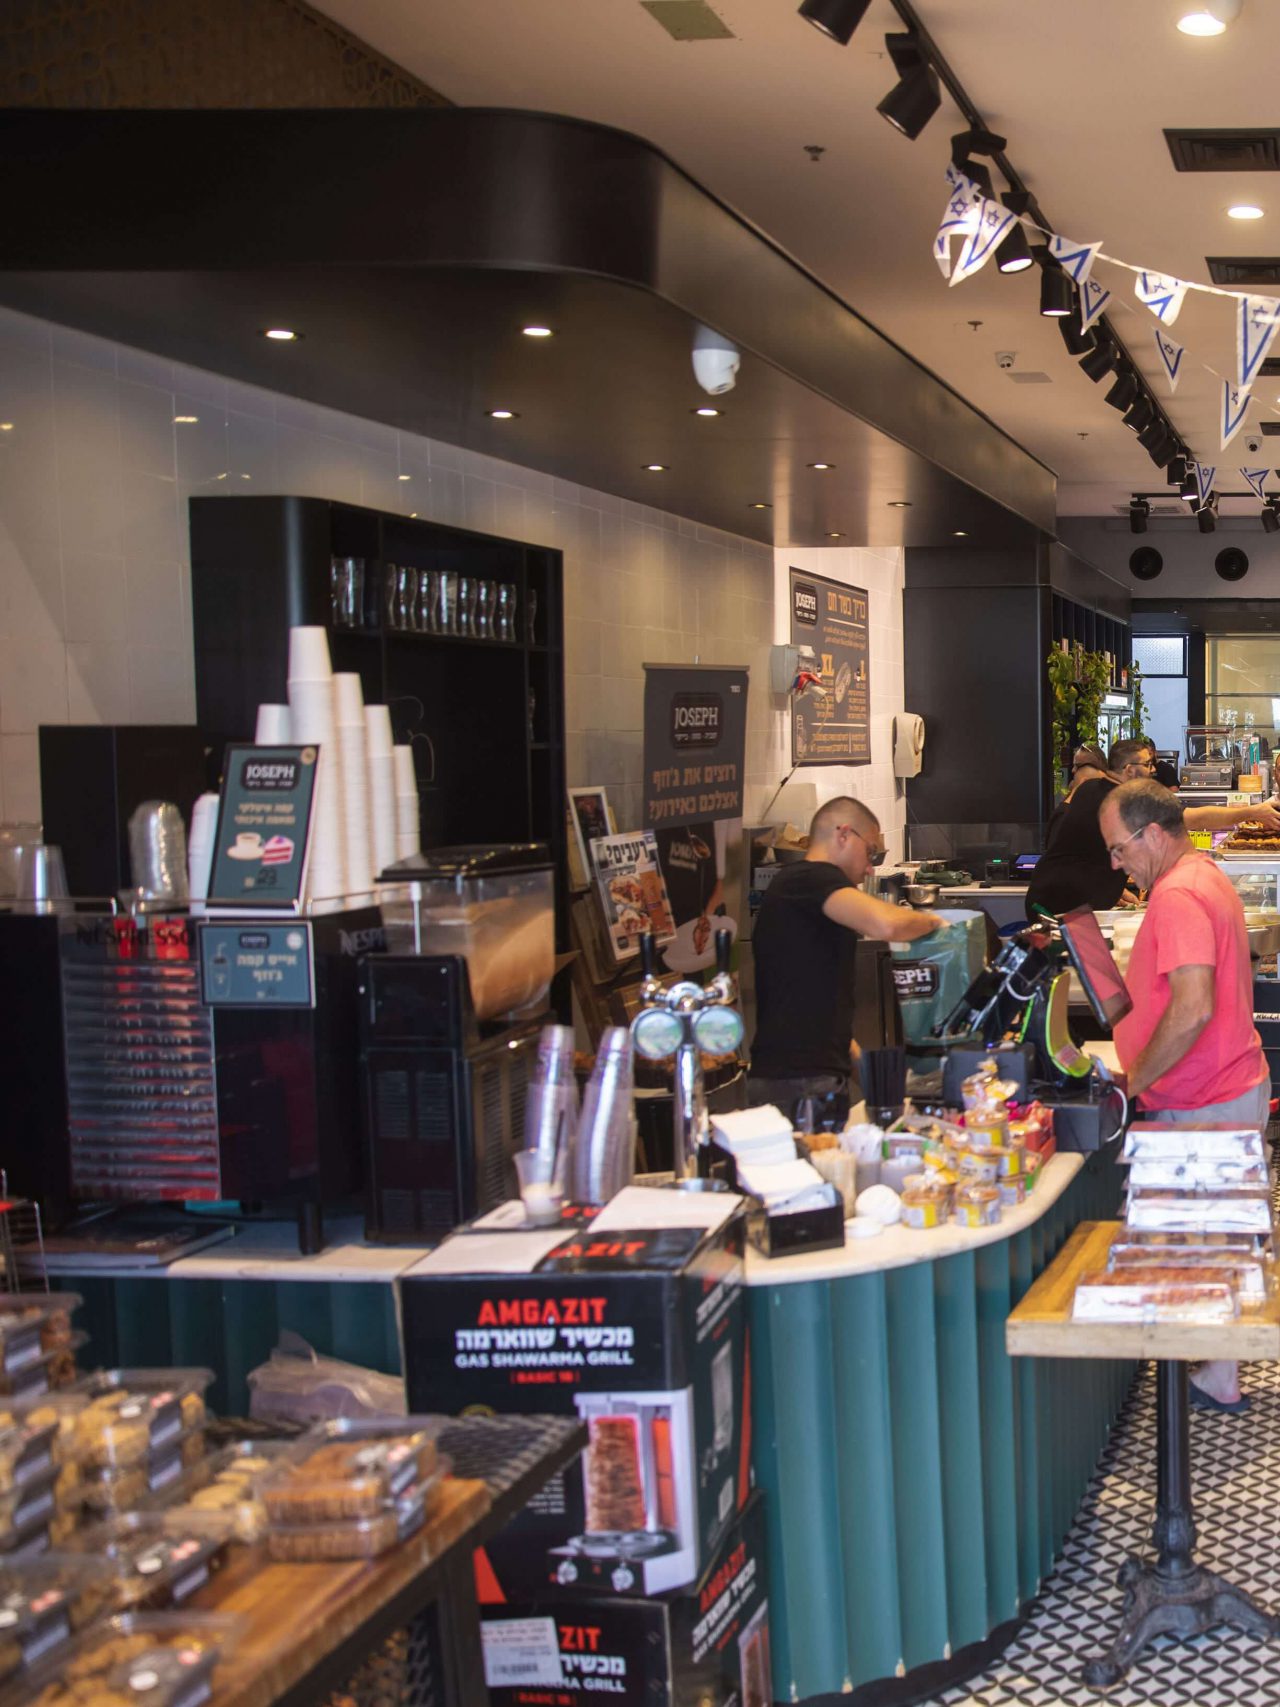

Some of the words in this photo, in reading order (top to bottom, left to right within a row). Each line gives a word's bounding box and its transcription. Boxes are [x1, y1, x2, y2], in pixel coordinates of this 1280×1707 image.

[795, 591, 816, 611] JOSEPH
[674, 707, 718, 730] JOSEPH
[246, 764, 295, 780] JOSEPH
[683, 767, 701, 787] את
[704, 764, 737, 784] רוצים
[699, 789, 738, 813] אצלכם
[892, 967, 931, 985] SEPH
[477, 1297, 607, 1326] AMGAZIT
[455, 1328, 557, 1351] שווארמה
[559, 1326, 635, 1349] מכשיר
[455, 1353, 490, 1369] GAS
[491, 1351, 585, 1369] SHAWARMA
[586, 1350, 635, 1366] GRILL
[583, 1677, 627, 1693] GRILL
